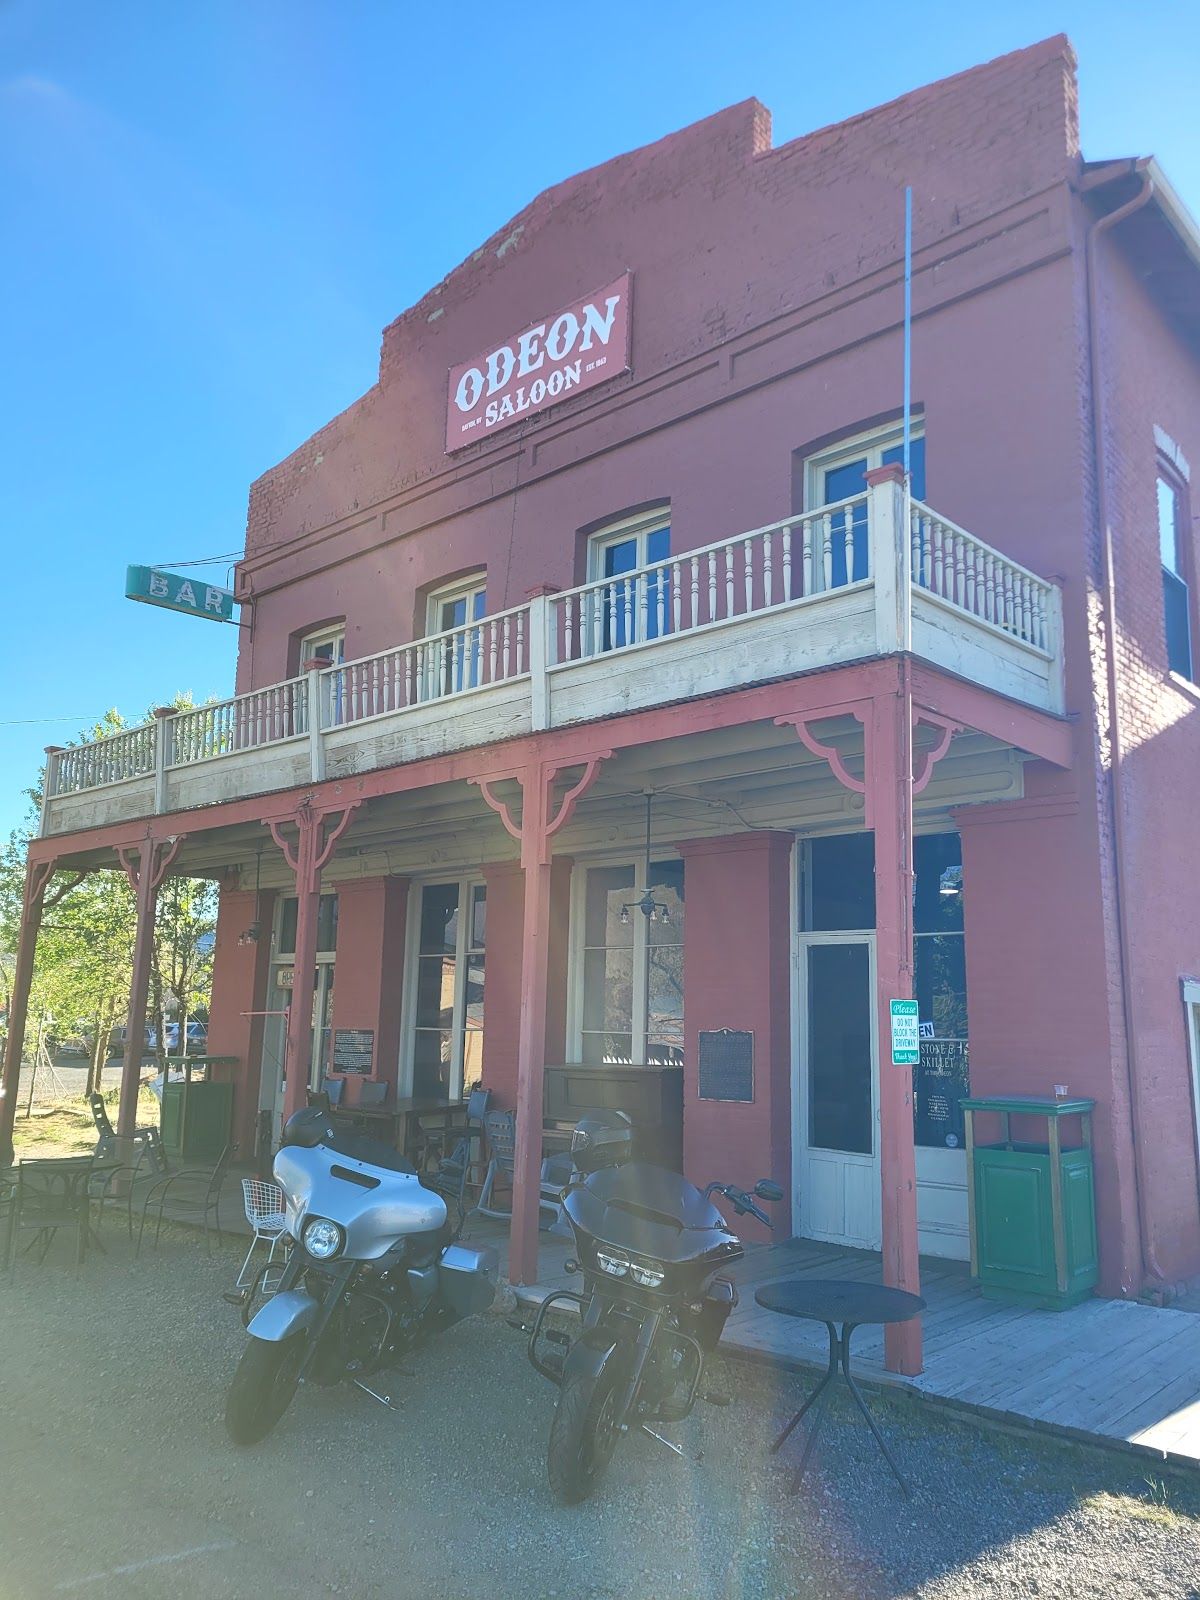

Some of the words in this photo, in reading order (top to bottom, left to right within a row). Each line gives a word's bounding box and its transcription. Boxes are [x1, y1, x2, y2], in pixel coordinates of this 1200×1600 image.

[454, 295, 620, 412] ODEON
[486, 359, 581, 427] SALOON
[149, 571, 223, 614] BAR
[893, 1003, 916, 1014] Please
[897, 1018, 904, 1026] DO
[894, 1028, 907, 1037] BLOCK
[896, 1039, 916, 1047] DRIVEWAY
[921, 1044, 945, 1055] STONE
[922, 1057, 954, 1068] SKILLET
